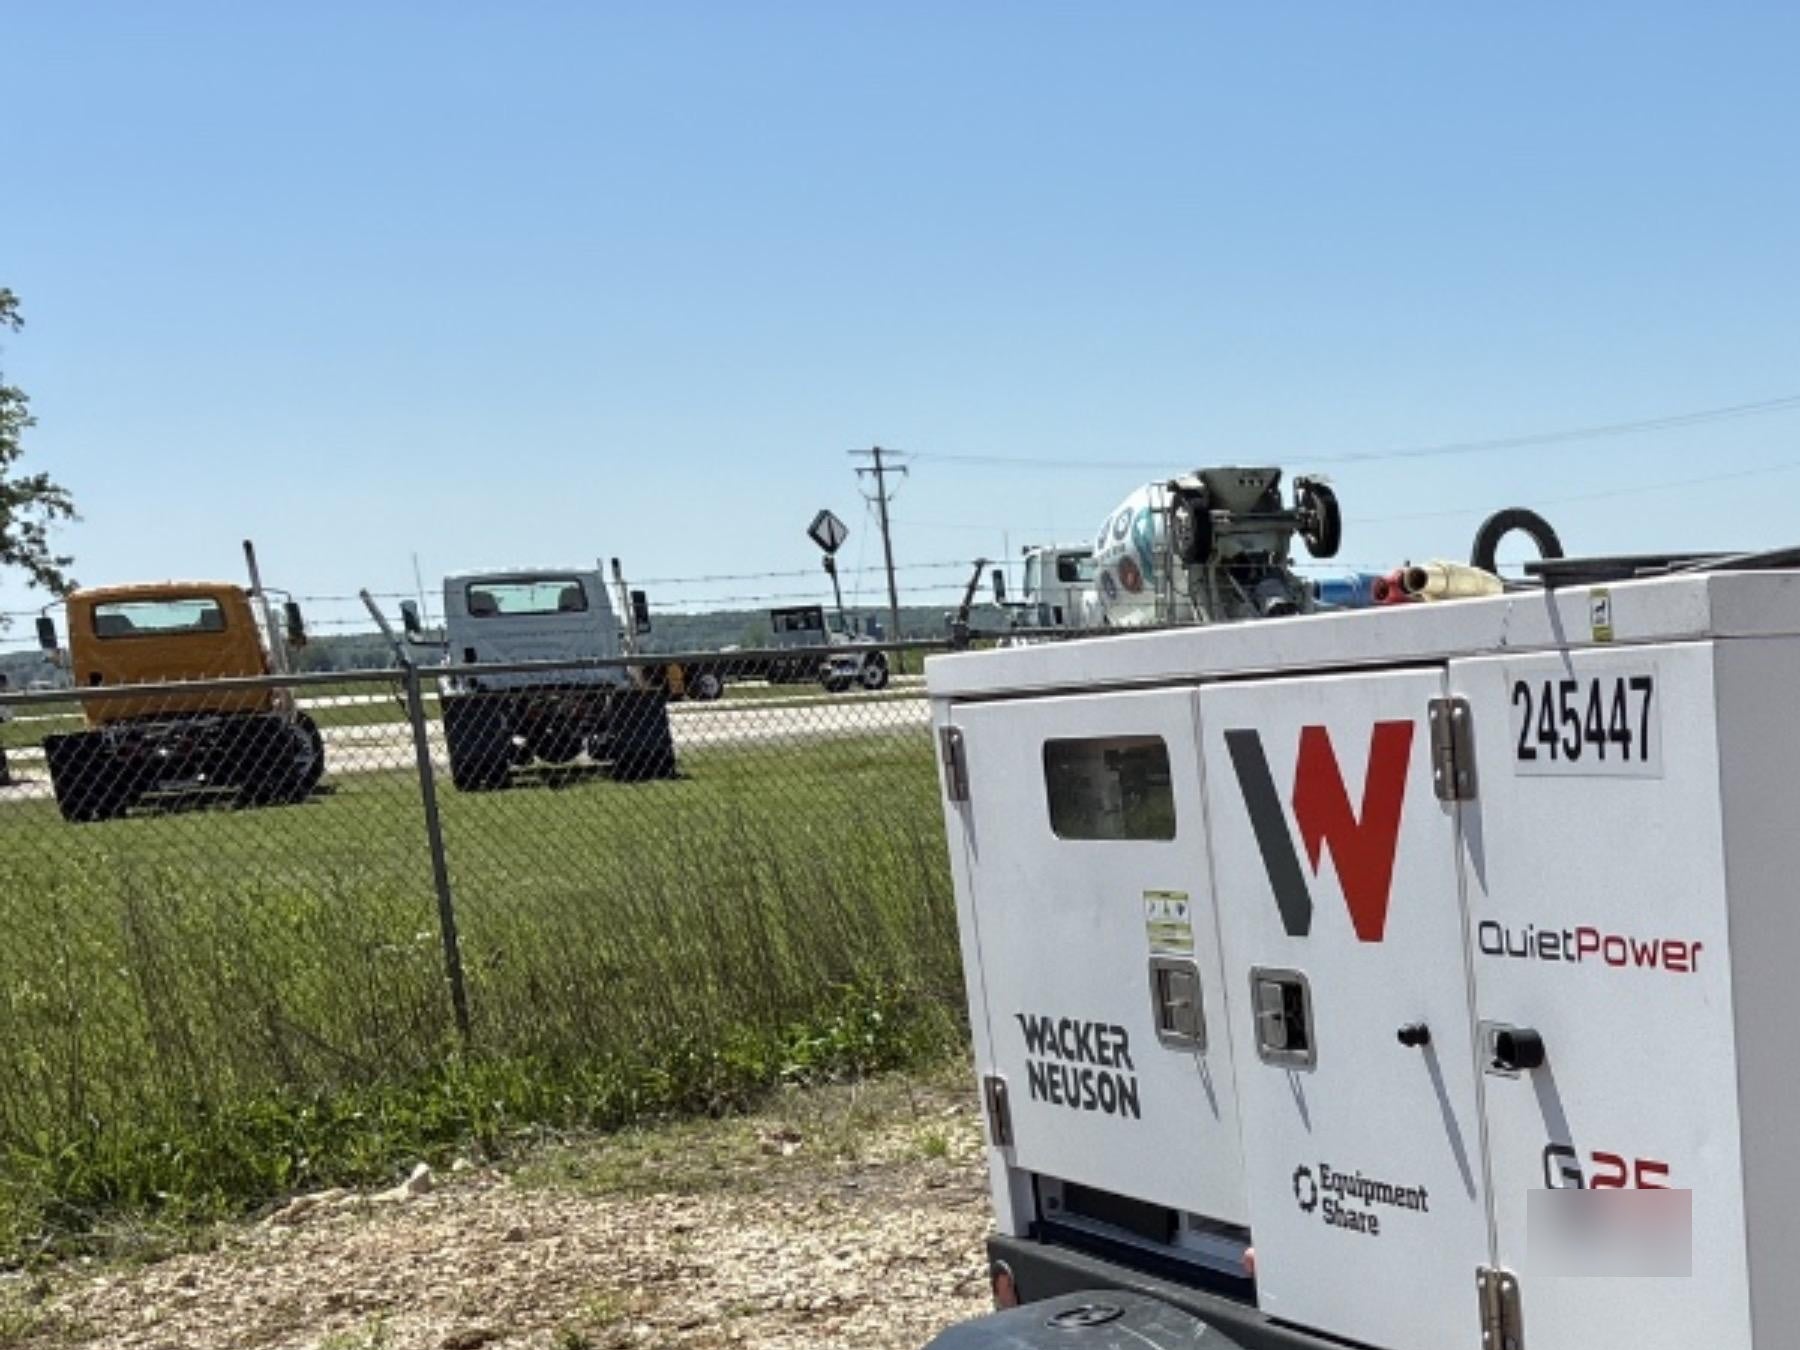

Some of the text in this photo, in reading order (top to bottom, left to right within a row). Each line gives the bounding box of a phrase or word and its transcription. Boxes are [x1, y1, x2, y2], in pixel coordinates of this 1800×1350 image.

[1512, 675, 1653, 761] 245447
[1478, 920, 1703, 973] QuietPower
[1013, 1013, 1135, 1071] WACKER
[1026, 1059, 1141, 1120] NEUSON
[1318, 1162, 1429, 1213] Equipment
[1322, 1197, 1380, 1236] Share
